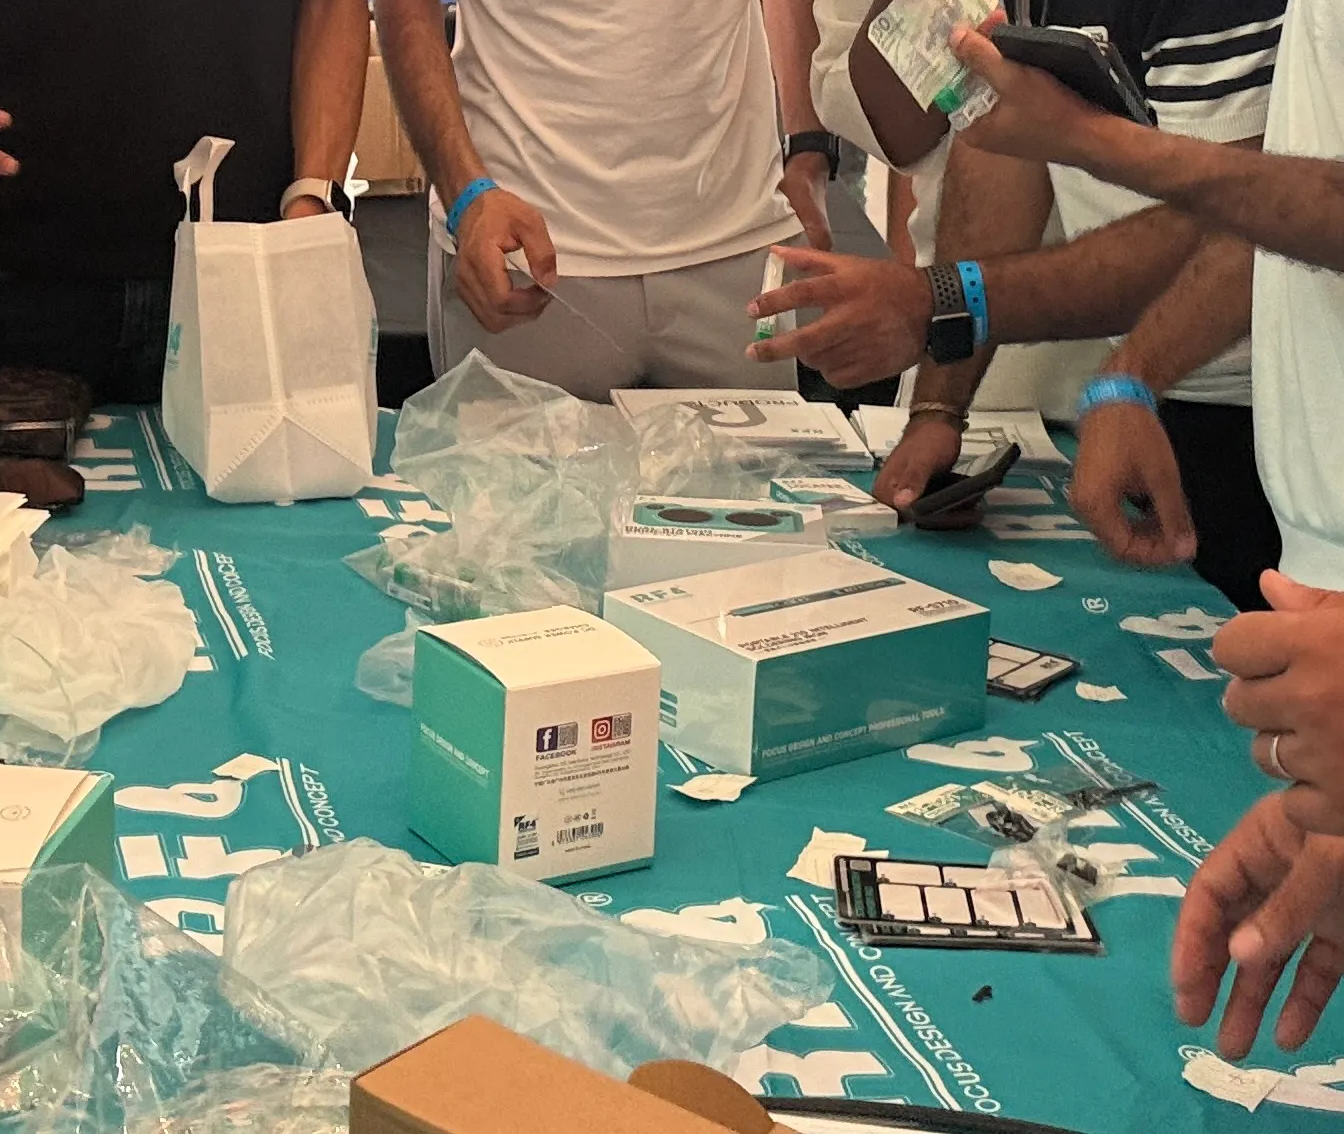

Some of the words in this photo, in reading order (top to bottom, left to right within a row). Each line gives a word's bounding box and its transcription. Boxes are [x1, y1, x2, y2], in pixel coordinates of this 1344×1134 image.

[535, 749, 578, 762] FACEBOOK
[869, 964, 914, 1000] AND
[894, 1000, 959, 1062] DESIGN
[946, 1061, 1002, 1114] OCUS
